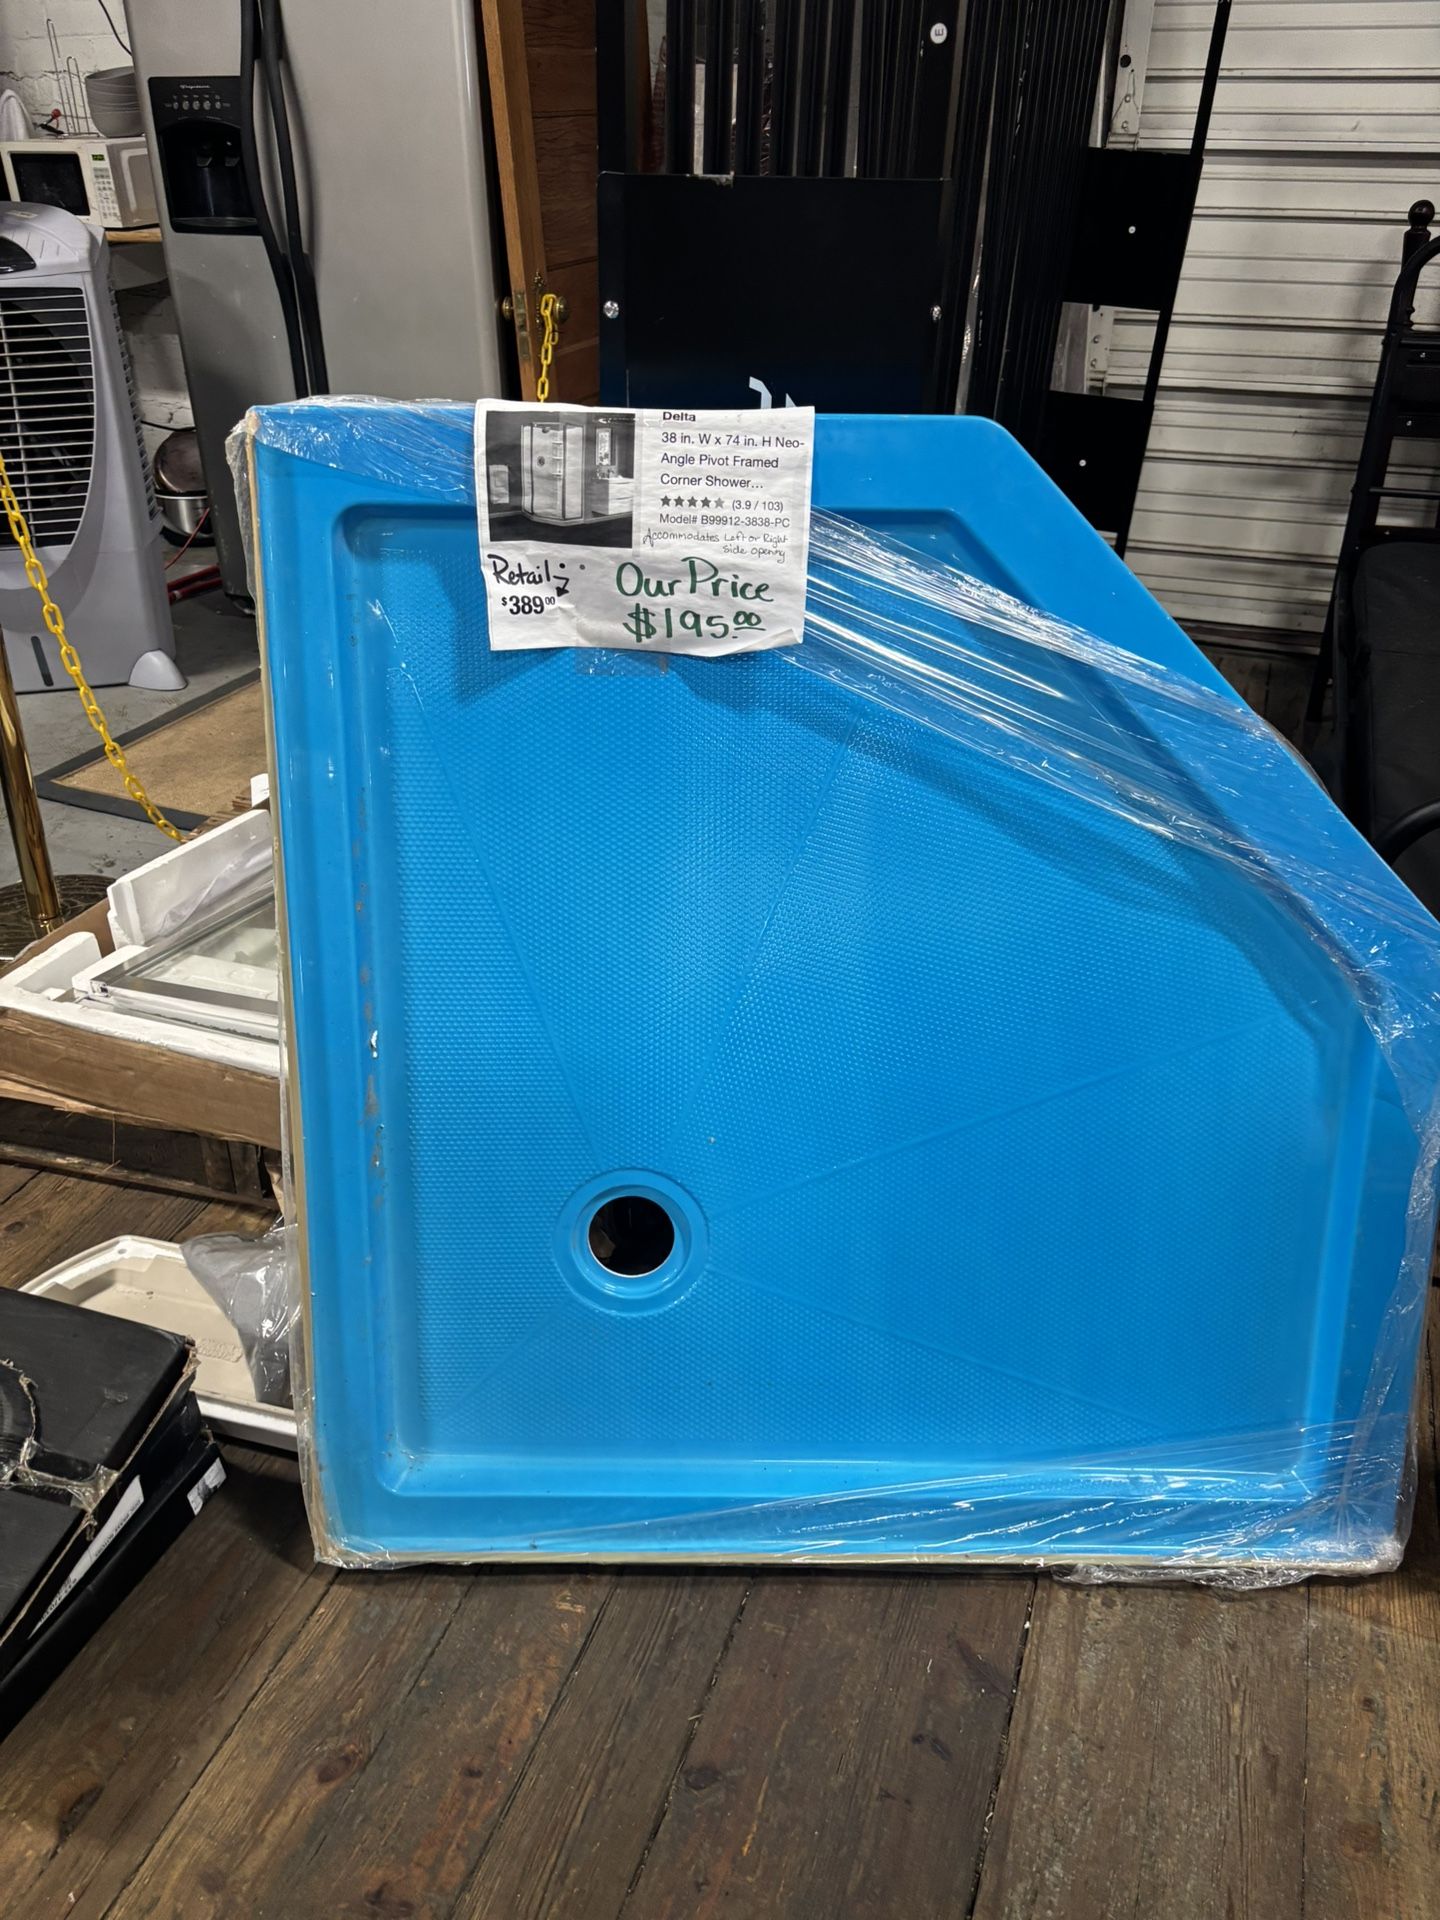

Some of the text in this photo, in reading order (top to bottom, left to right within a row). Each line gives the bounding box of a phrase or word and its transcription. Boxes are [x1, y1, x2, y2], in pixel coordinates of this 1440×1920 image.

[662, 411, 697, 422] Delta
[661, 432, 805, 448] 38 in. W x 74 in. H Neo-
[660, 452, 779, 468] Angle Pivot Framed
[660, 473, 764, 489] Corner Shower...
[731, 500, 751, 511] (3.9
[762, 501, 784, 512] 103)
[659, 513, 790, 528] Model# B99912-3838-PC
[724, 530, 747, 541] Left
[763, 533, 789, 549] Right
[616, 556, 774, 602] Our Price
